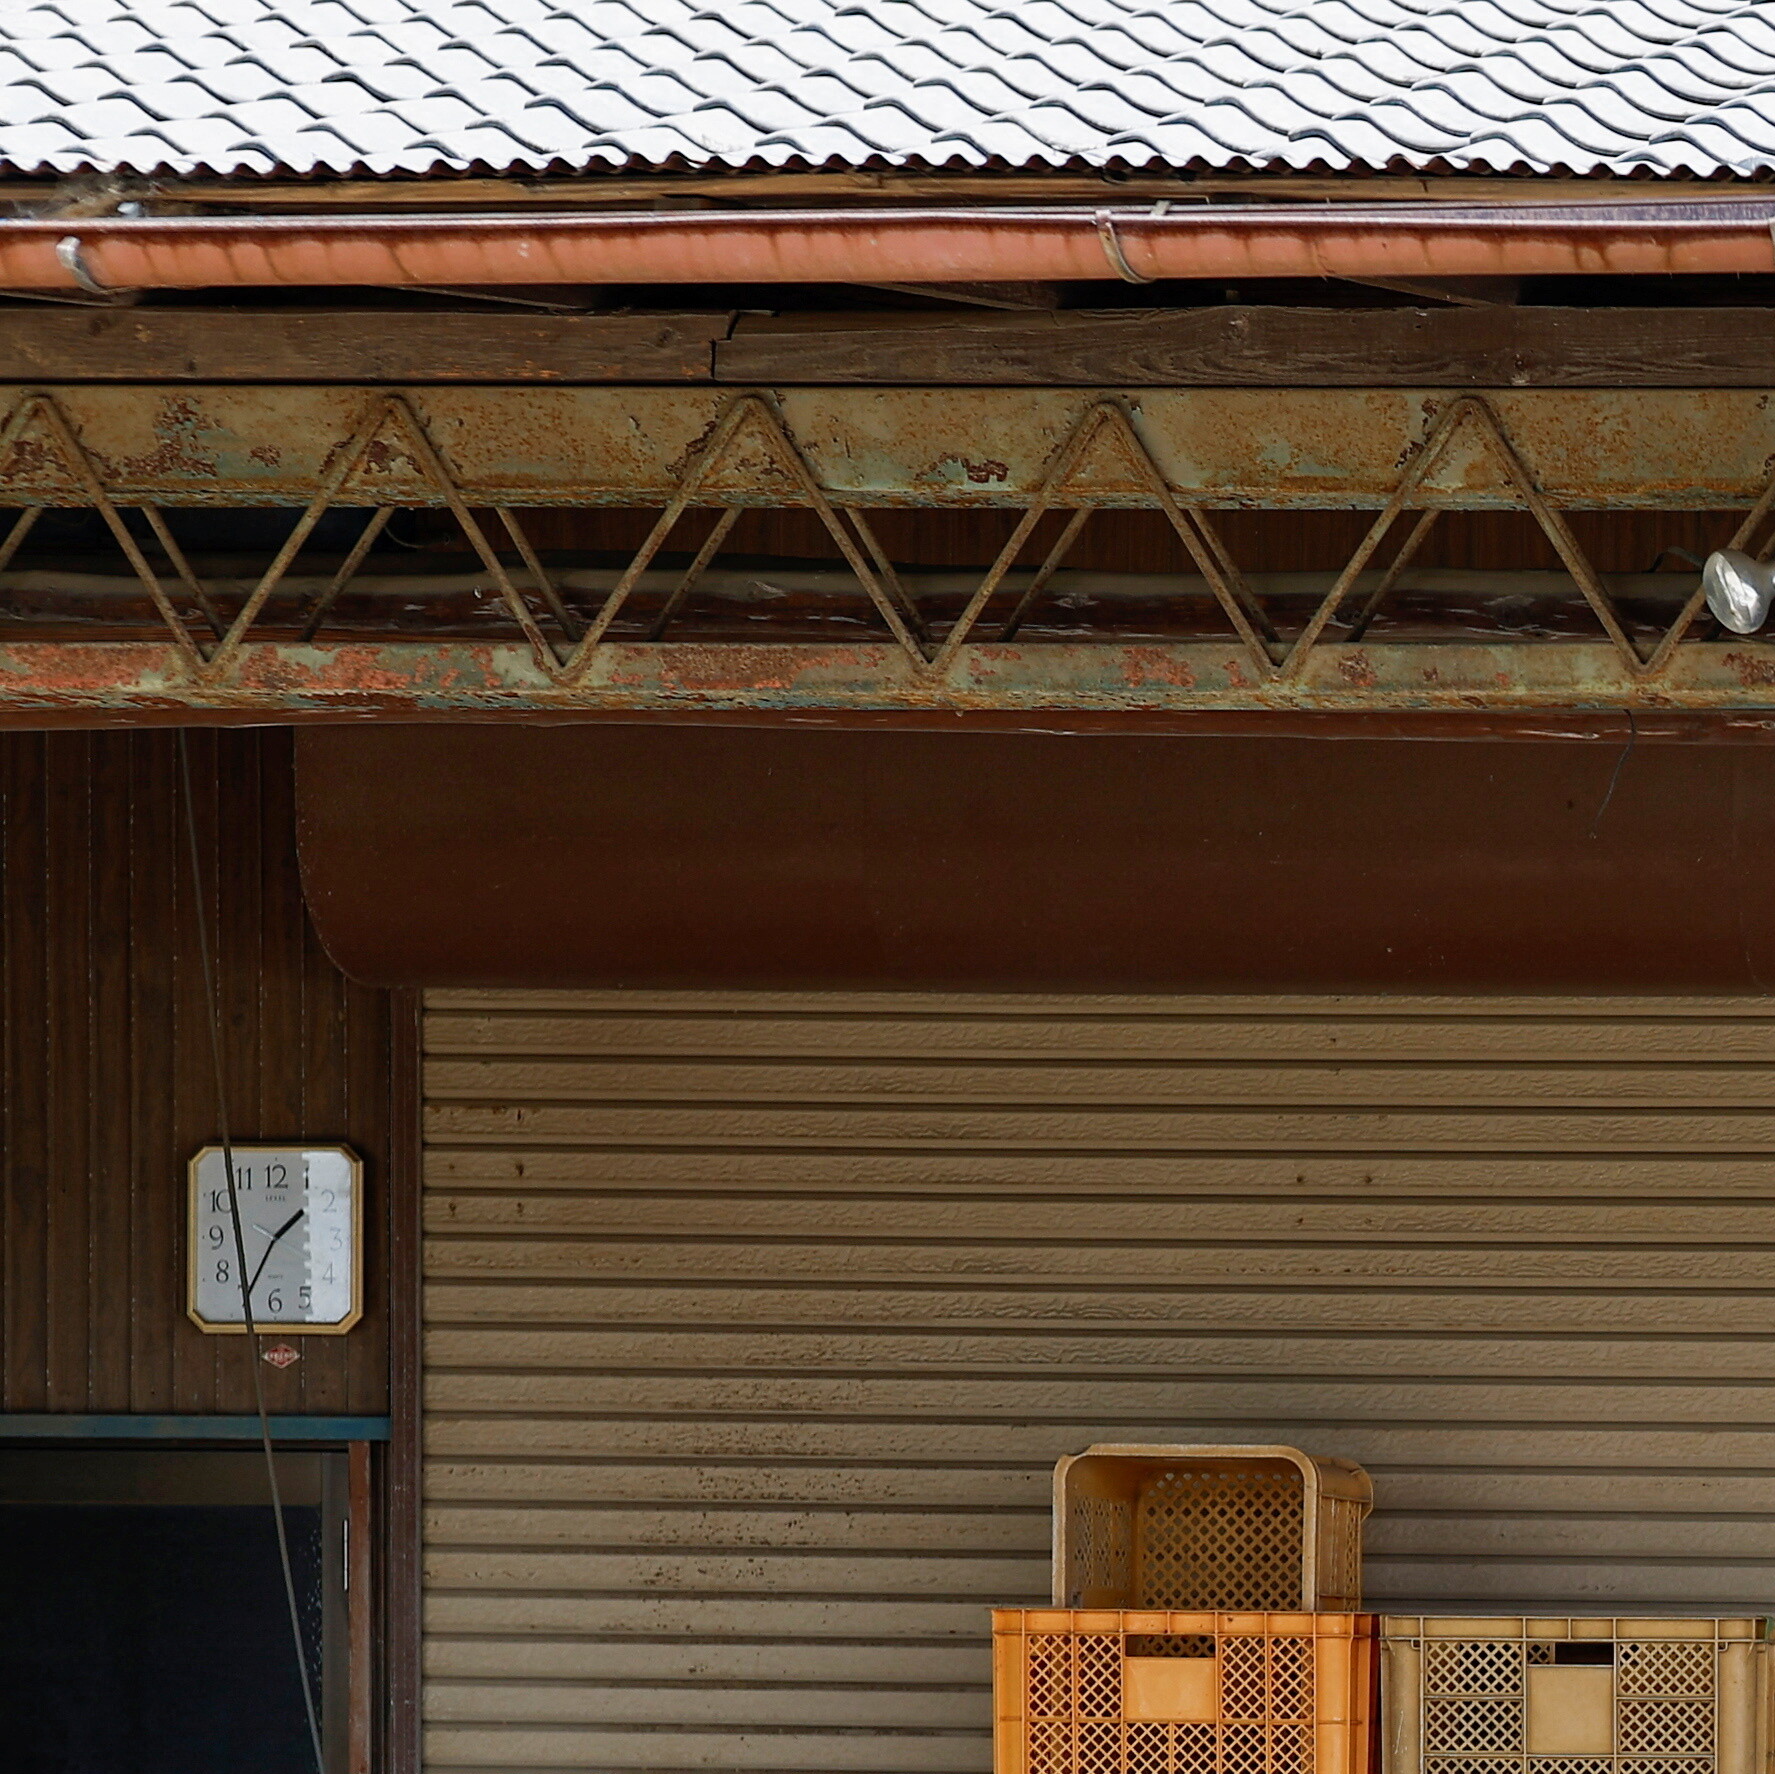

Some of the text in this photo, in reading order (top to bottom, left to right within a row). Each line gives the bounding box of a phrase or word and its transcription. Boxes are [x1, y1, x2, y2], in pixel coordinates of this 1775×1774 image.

[236, 1166, 253, 1191] 11
[265, 1164, 289, 1189] 12
[210, 1189, 233, 1214] 10
[321, 1190, 337, 1213] 2
[209, 1225, 224, 1250] 9
[330, 1229, 343, 1251] 3
[216, 1259, 229, 1283] 8
[322, 1263, 336, 1284] 4
[268, 1288, 283, 1313] 6
[299, 1286, 312, 1309] 5
